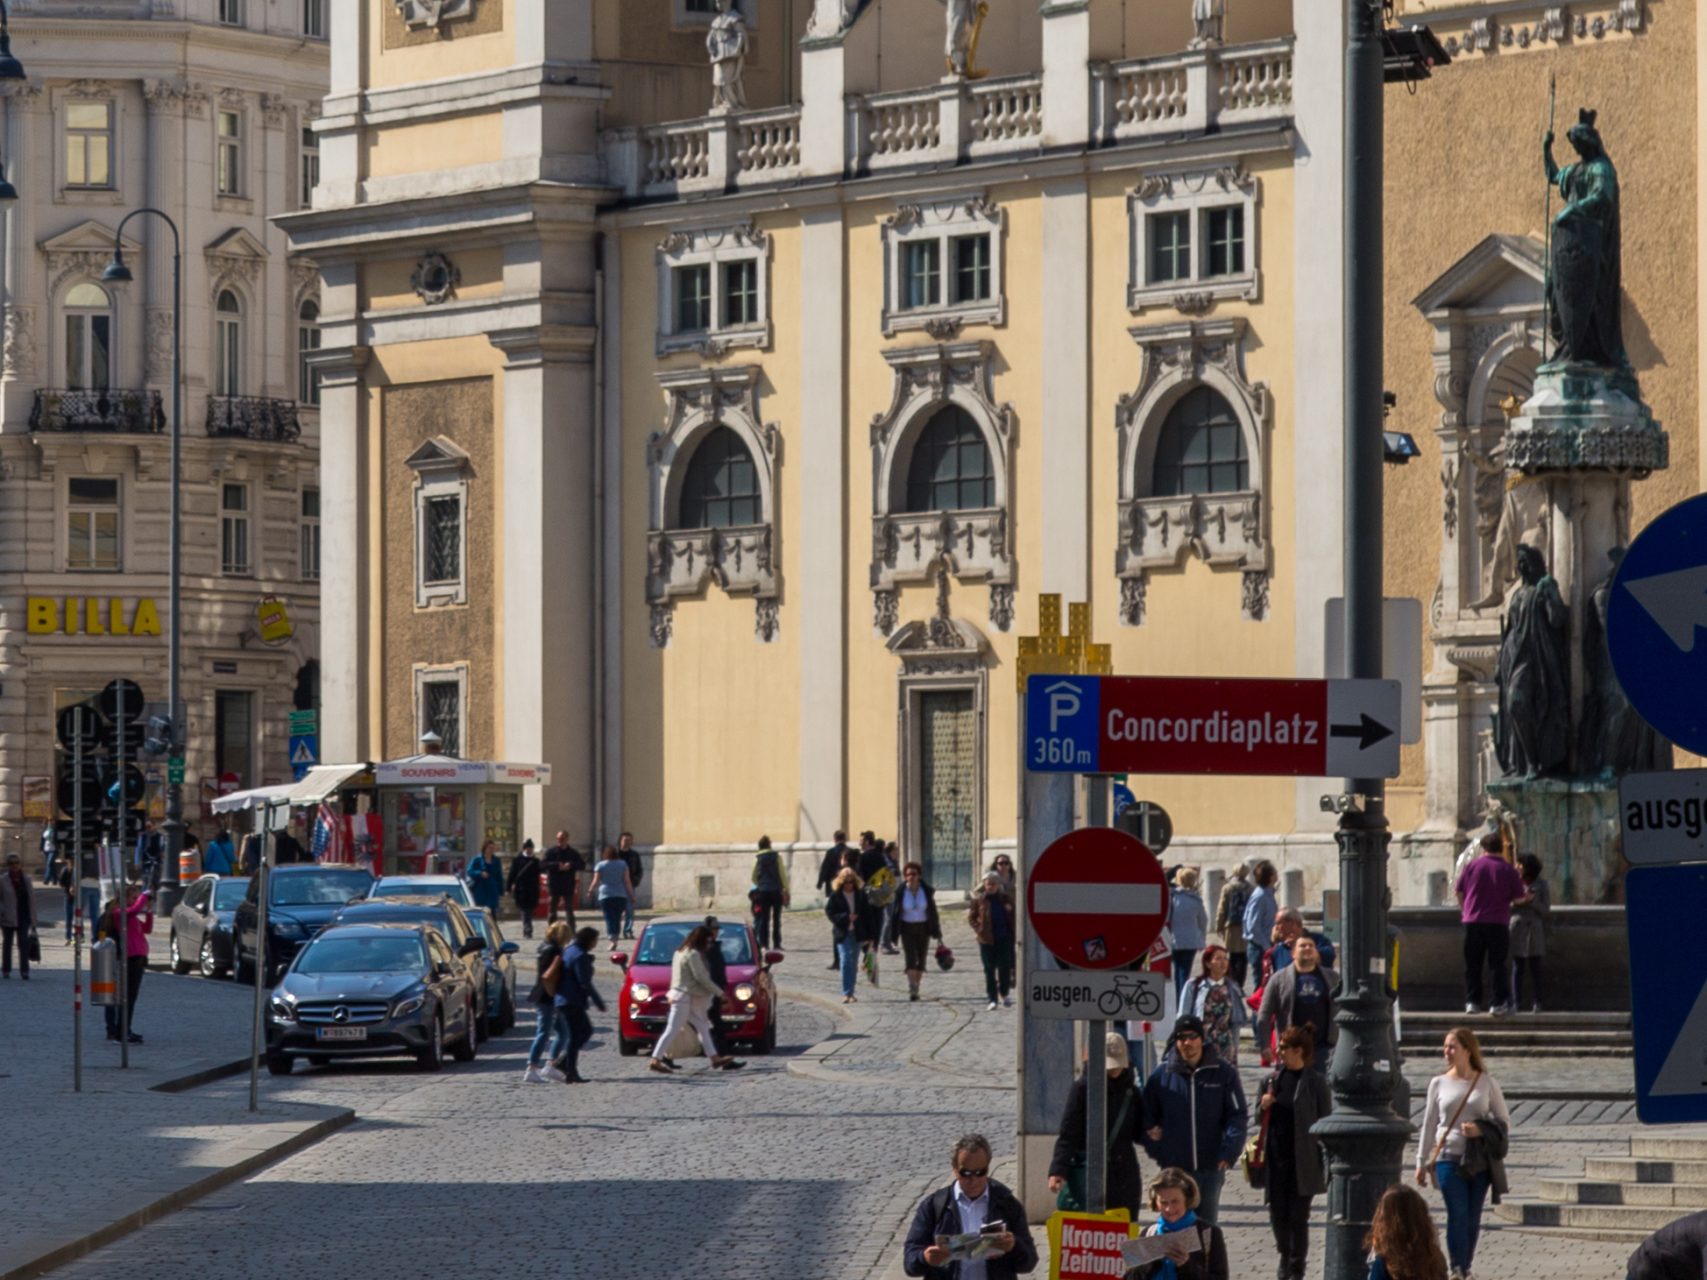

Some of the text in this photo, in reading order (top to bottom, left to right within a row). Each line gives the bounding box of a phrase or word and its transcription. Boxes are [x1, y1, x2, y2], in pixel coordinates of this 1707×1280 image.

[27, 595, 161, 636] BILLA
[1050, 694, 1081, 732] P
[1107, 708, 1319, 752] Concordiaplatz
[401, 768, 457, 778] SOUVENIRS
[1626, 798, 1707, 839] ausg
[1033, 984, 1097, 1008] ausgen.
[1062, 1224, 1128, 1251] Kronen
[1060, 1249, 1126, 1278] Zeitung
